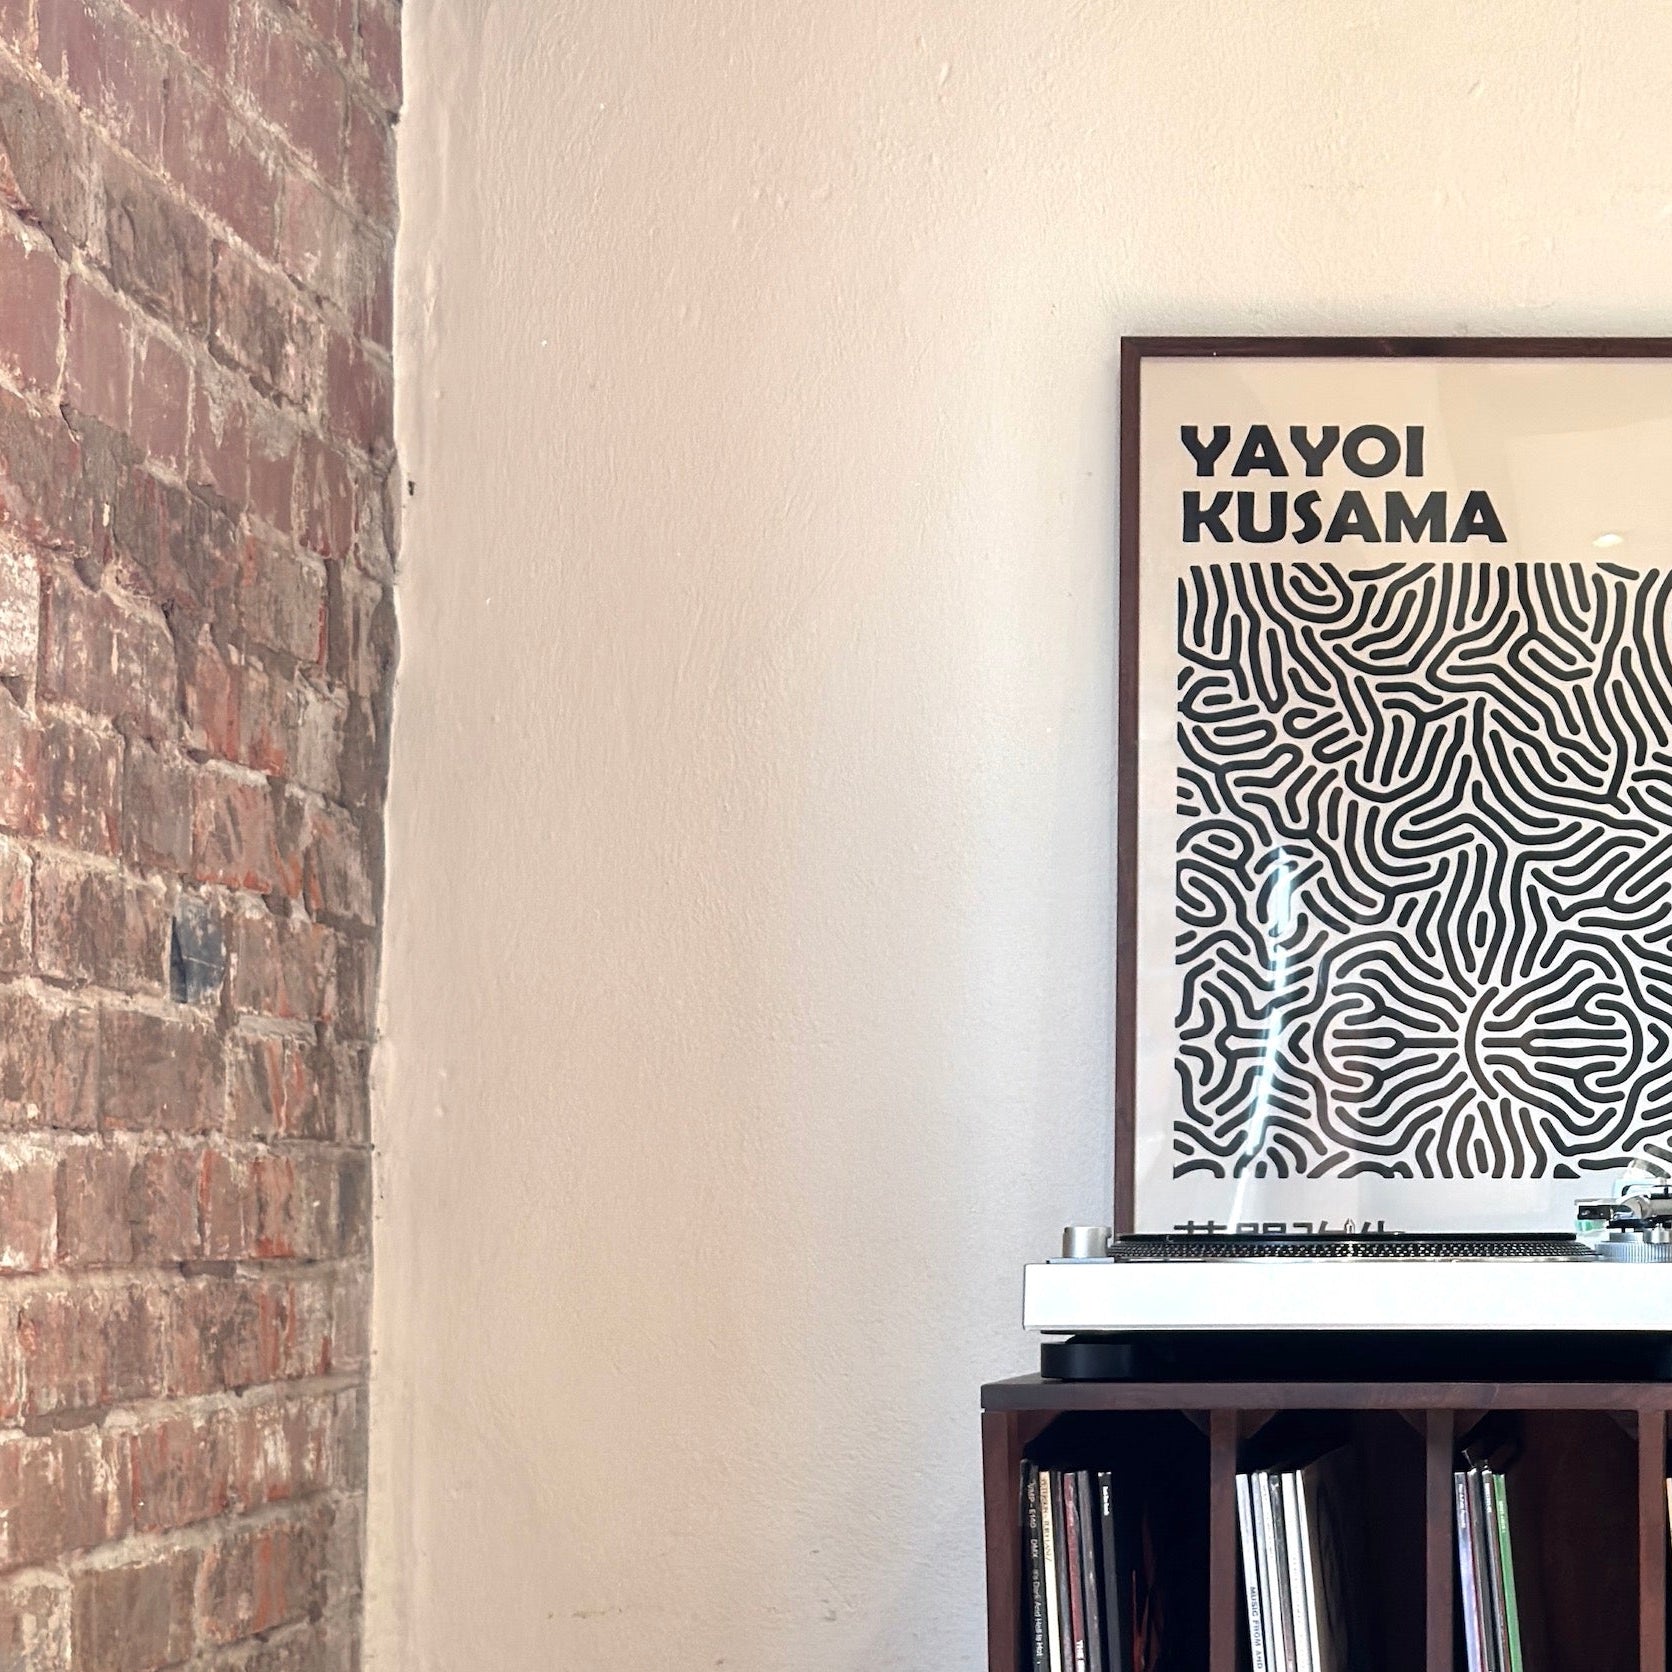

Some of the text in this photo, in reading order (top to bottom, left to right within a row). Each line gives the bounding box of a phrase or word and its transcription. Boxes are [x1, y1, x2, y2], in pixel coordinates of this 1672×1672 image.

[1181, 424, 1425, 477] YAYOI
[1182, 490, 1507, 543] KUSAMA
[1030, 1538, 1039, 1558] DMX
[1033, 1601, 1043, 1617] And
[1250, 1585, 1259, 1617] MUSIC
[1252, 1619, 1261, 1647] FROM
